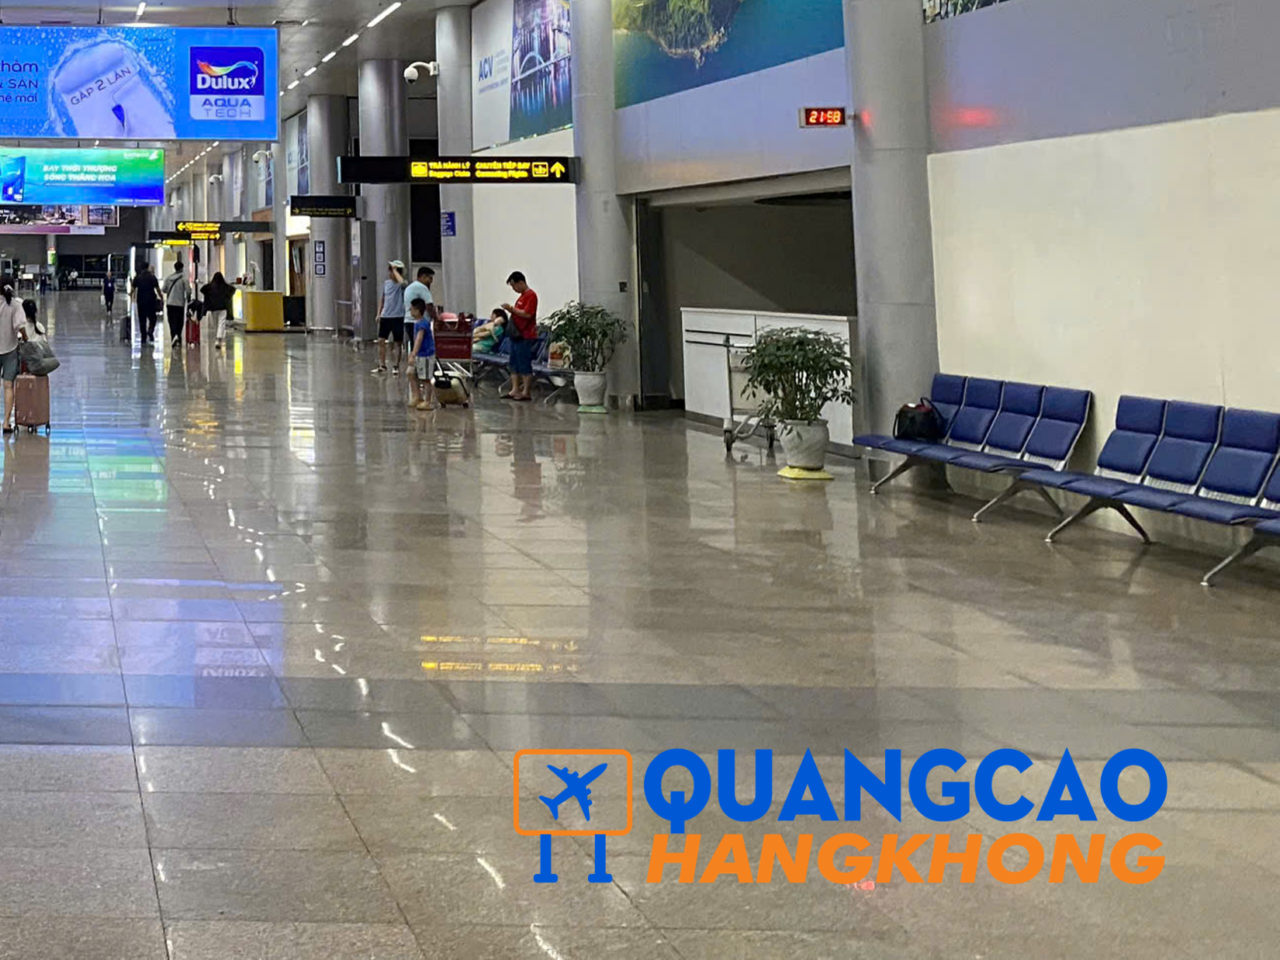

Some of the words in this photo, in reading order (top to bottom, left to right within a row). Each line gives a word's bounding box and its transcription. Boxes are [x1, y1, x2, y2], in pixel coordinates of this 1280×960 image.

[478, 55, 494, 82] ACV
[95, 79, 107, 91] 2
[196, 73, 250, 90] Dulux
[202, 98, 252, 108] AQUA
[204, 108, 251, 118] TECH
